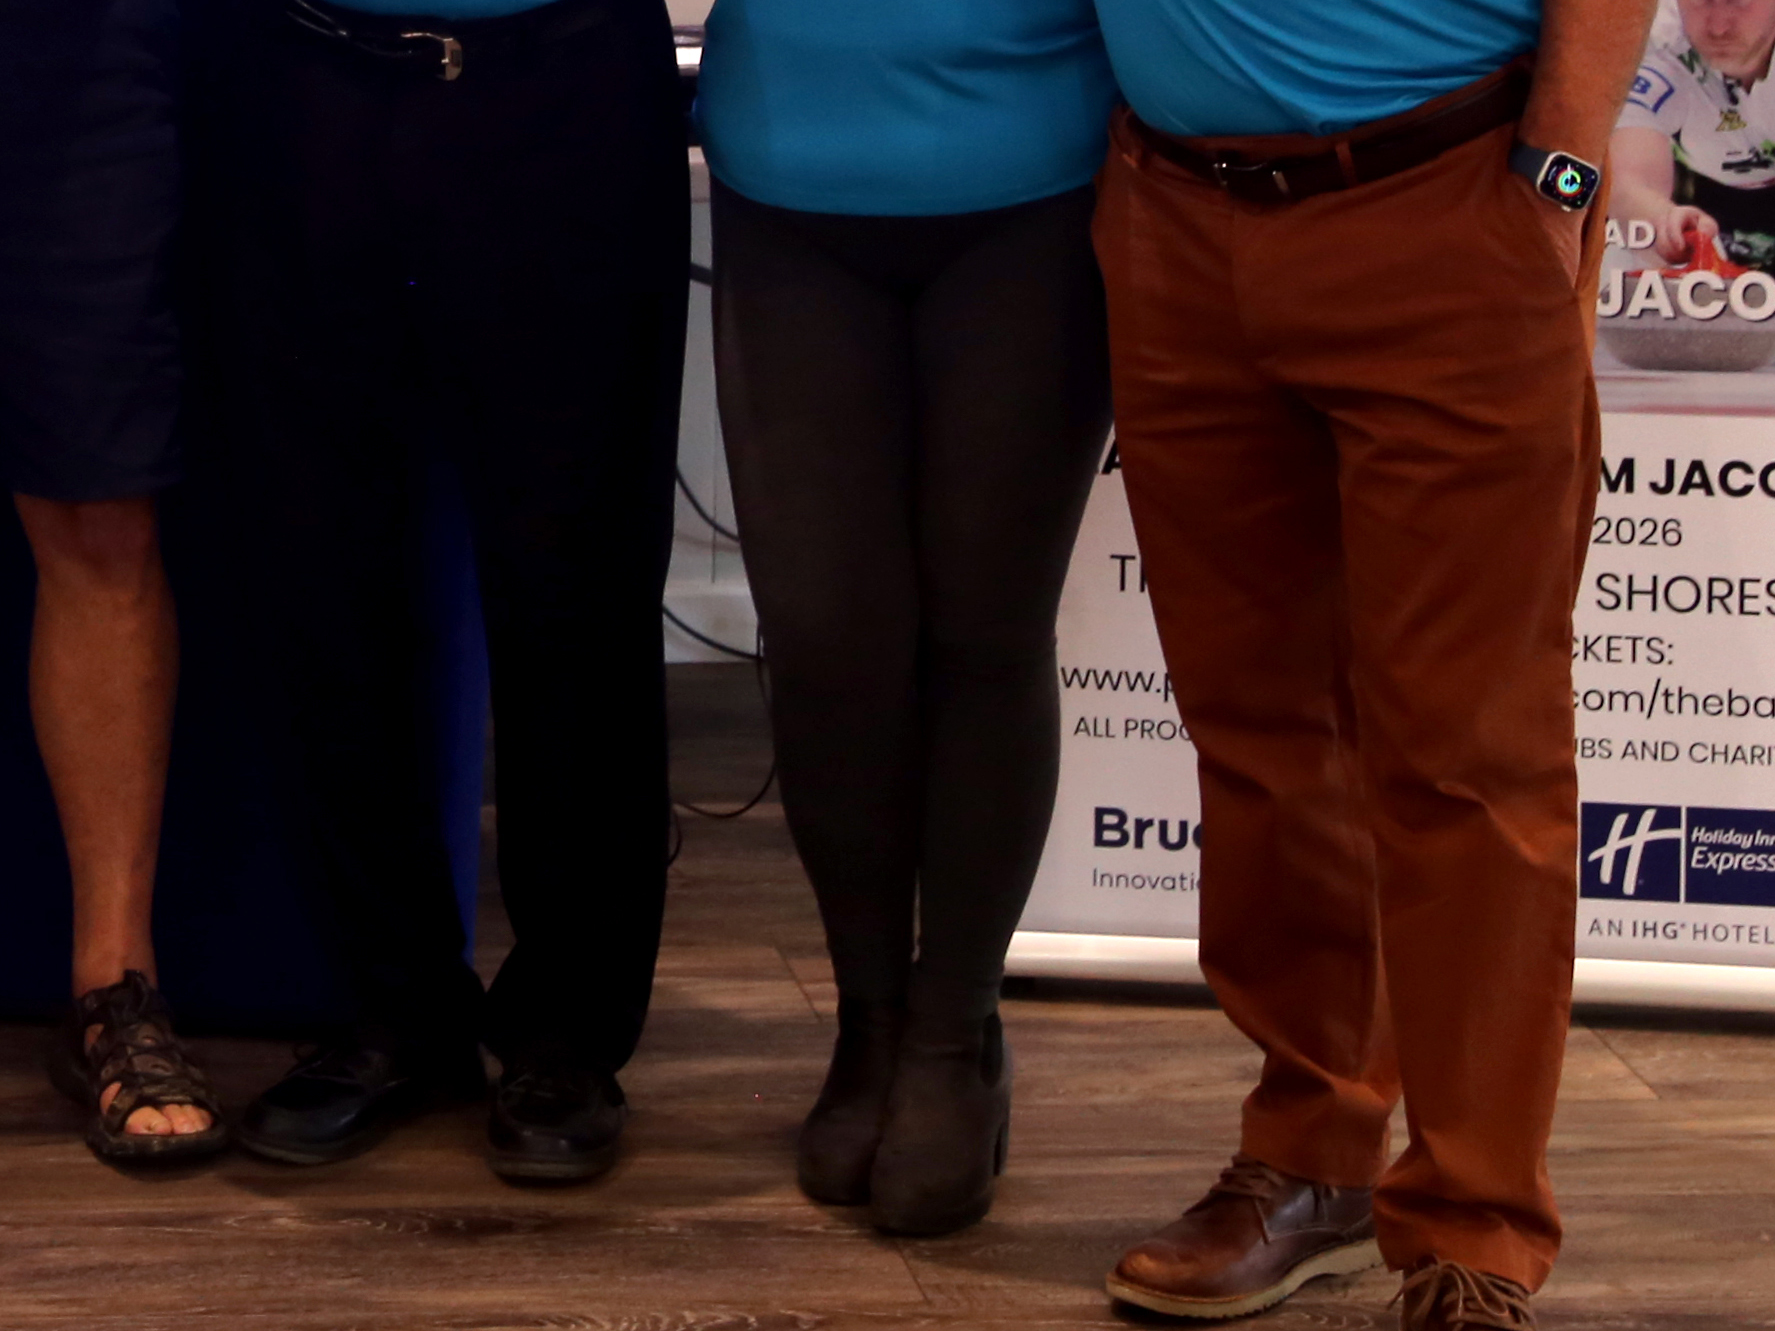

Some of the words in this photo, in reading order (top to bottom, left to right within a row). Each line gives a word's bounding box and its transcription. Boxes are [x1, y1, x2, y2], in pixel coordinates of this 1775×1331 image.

[1592, 516, 1683, 547] 2026
[1572, 634, 1674, 665] KETS:
[1074, 716, 1116, 738] ALL
[1574, 737, 1612, 759] BS
[1621, 739, 1680, 762] AND
[1689, 742, 1775, 766] CHARI
[1691, 826, 1753, 849] Holiday
[1588, 919, 1623, 936] AN
